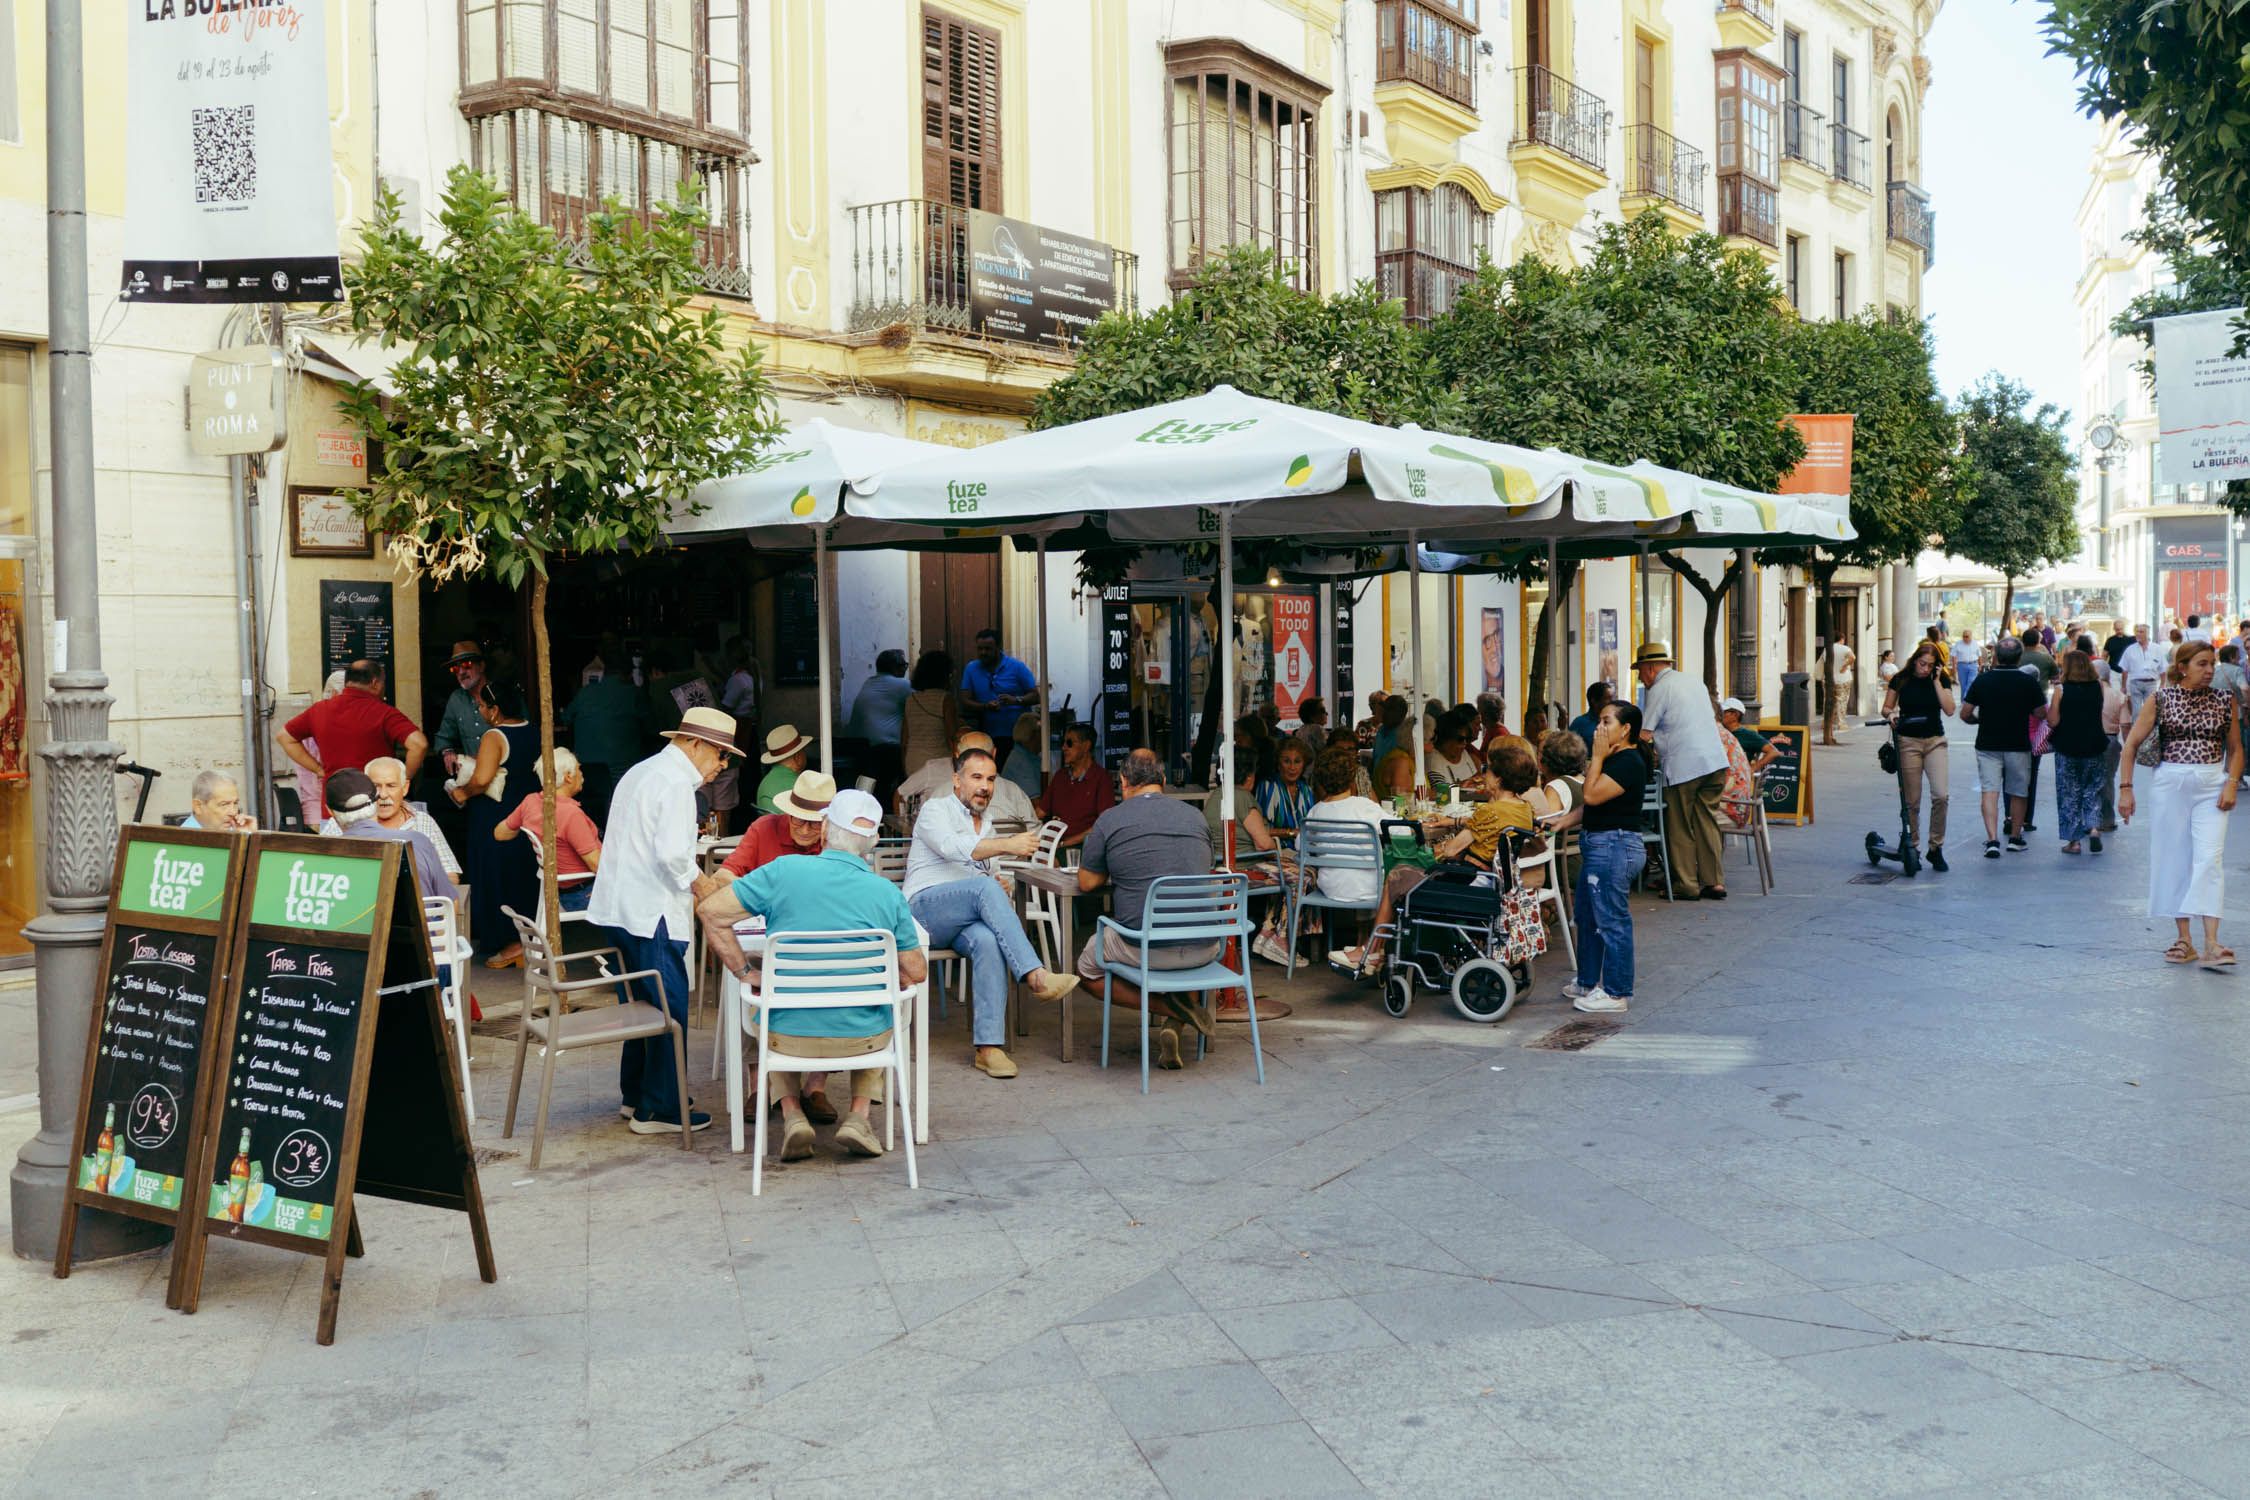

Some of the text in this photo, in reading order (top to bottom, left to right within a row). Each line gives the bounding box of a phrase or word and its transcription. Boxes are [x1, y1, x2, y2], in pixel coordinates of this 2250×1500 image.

[145, 0, 176, 22] LA
[207, 362, 255, 387] PUNT
[205, 413, 259, 439] ROMA
[1141, 418, 1259, 435] fuze
[2193, 459, 2206, 469] LA
[2209, 453, 2249, 467] BULERÍA
[1405, 462, 1426, 483] fuze
[946, 479, 987, 498] fuze
[1408, 483, 1426, 498] tea
[948, 497, 978, 513] tea
[2166, 544, 2202, 557] GAES
[1103, 585, 1129, 601] OUTLET
[1279, 600, 1311, 614] TODO
[1280, 618, 1309, 631] TODO
[152, 848, 205, 887] fuze
[288, 860, 350, 901] fuze
[149, 880, 188, 911] tea
[285, 896, 332, 926] tea
[134, 1169, 160, 1191] fuze
[133, 1186, 153, 1202] tea
[275, 1198, 305, 1220] fuze
[274, 1215, 297, 1231] tea
